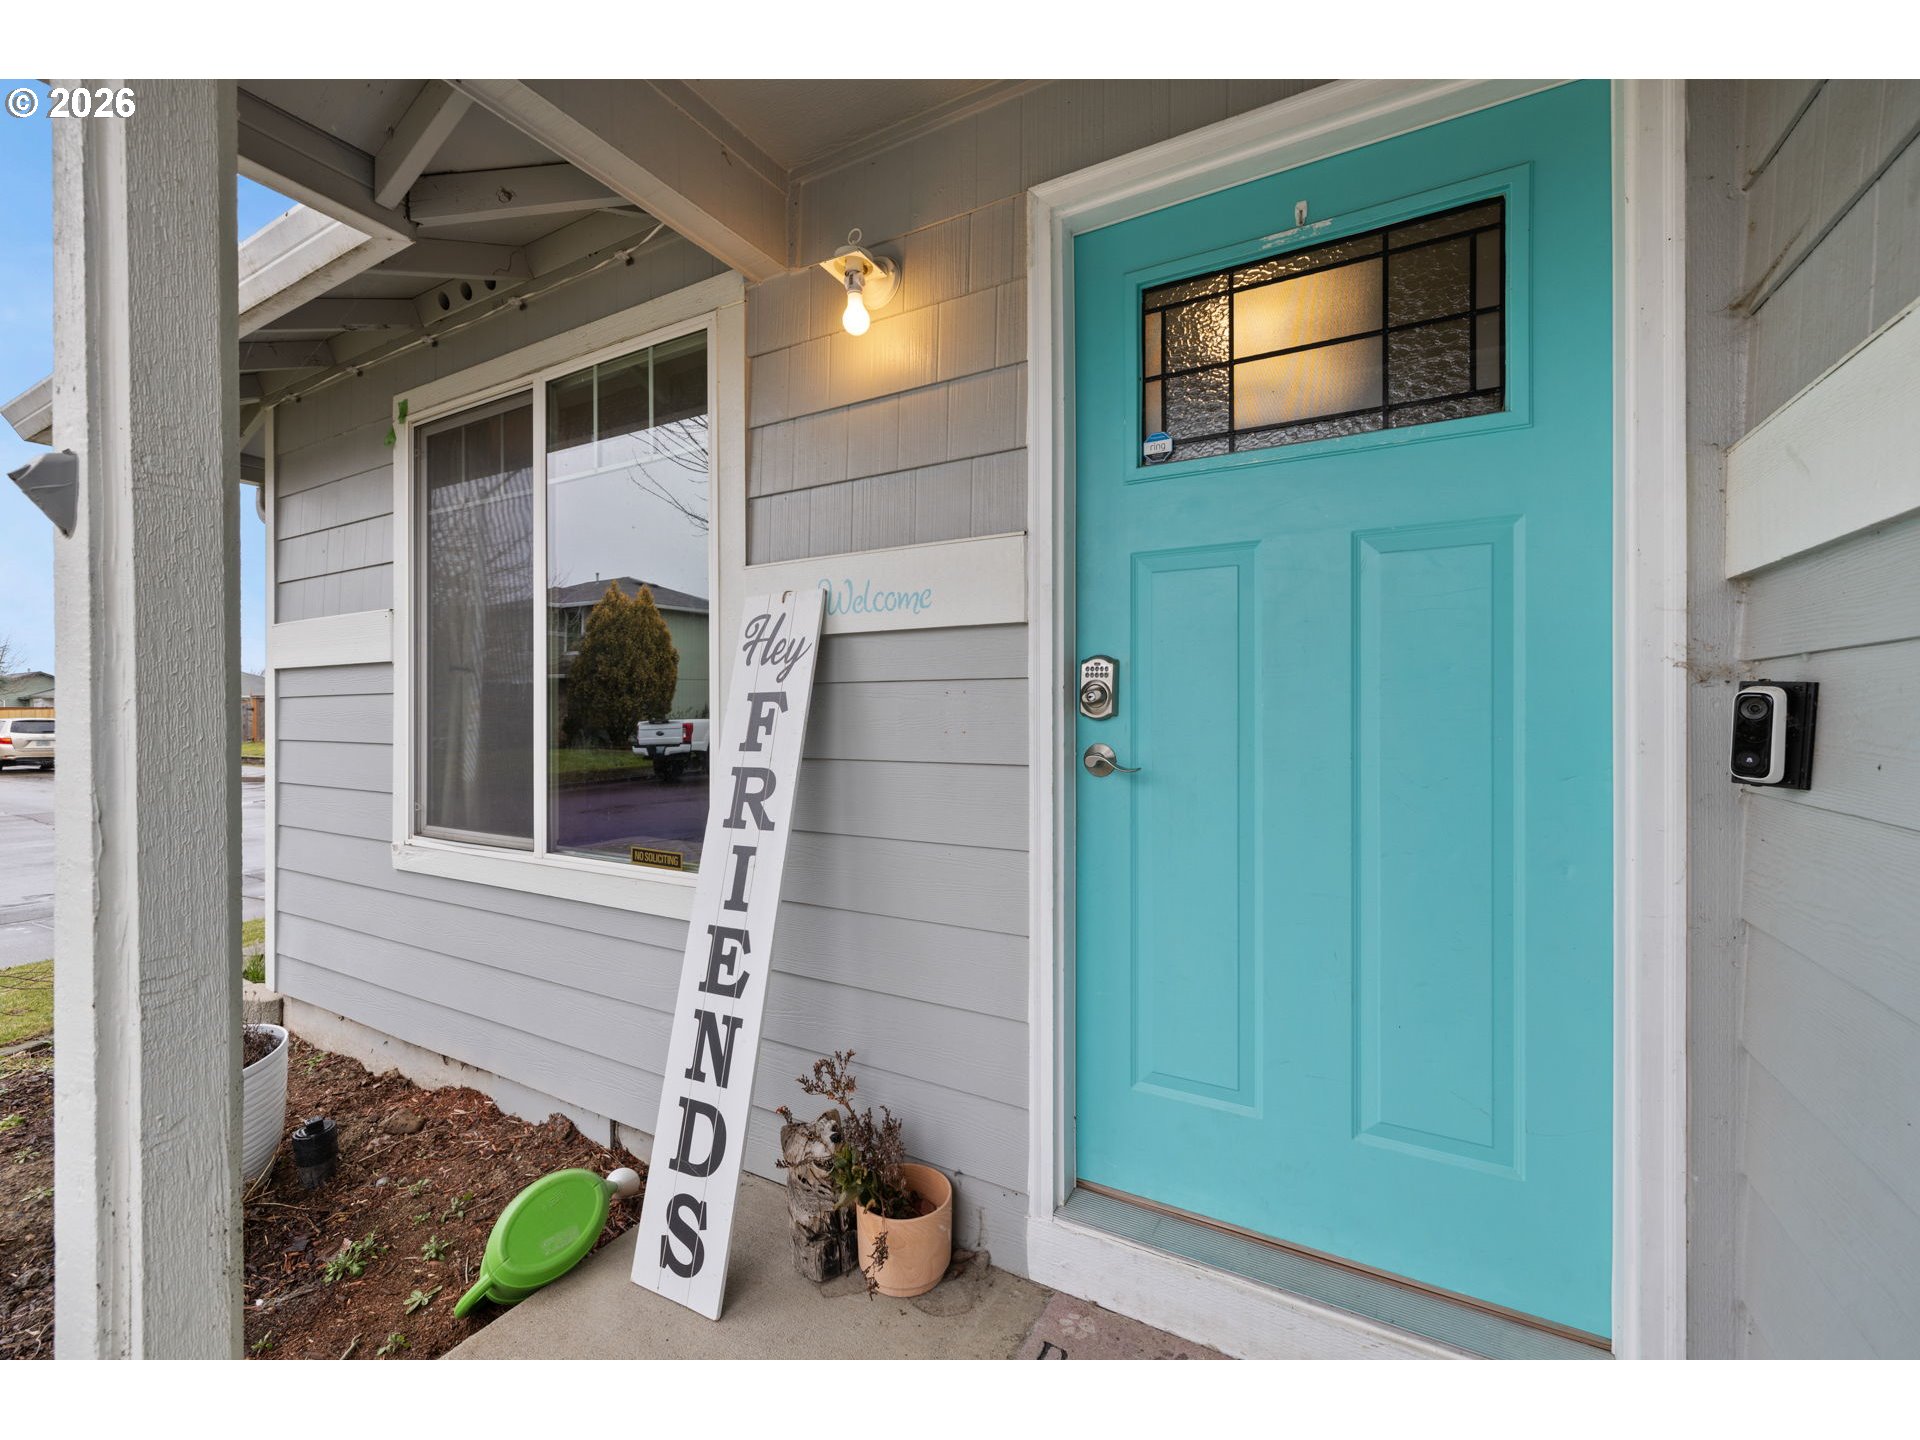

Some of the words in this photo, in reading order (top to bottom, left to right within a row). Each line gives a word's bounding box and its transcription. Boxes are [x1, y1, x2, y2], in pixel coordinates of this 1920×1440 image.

[1150, 442, 1166, 451] ring
[818, 578, 933, 616] Welcome
[742, 612, 813, 684] Hey
[634, 850, 644, 861] NO
[645, 852, 679, 866] SOLICITING
[659, 691, 788, 1279] FRIENDS
